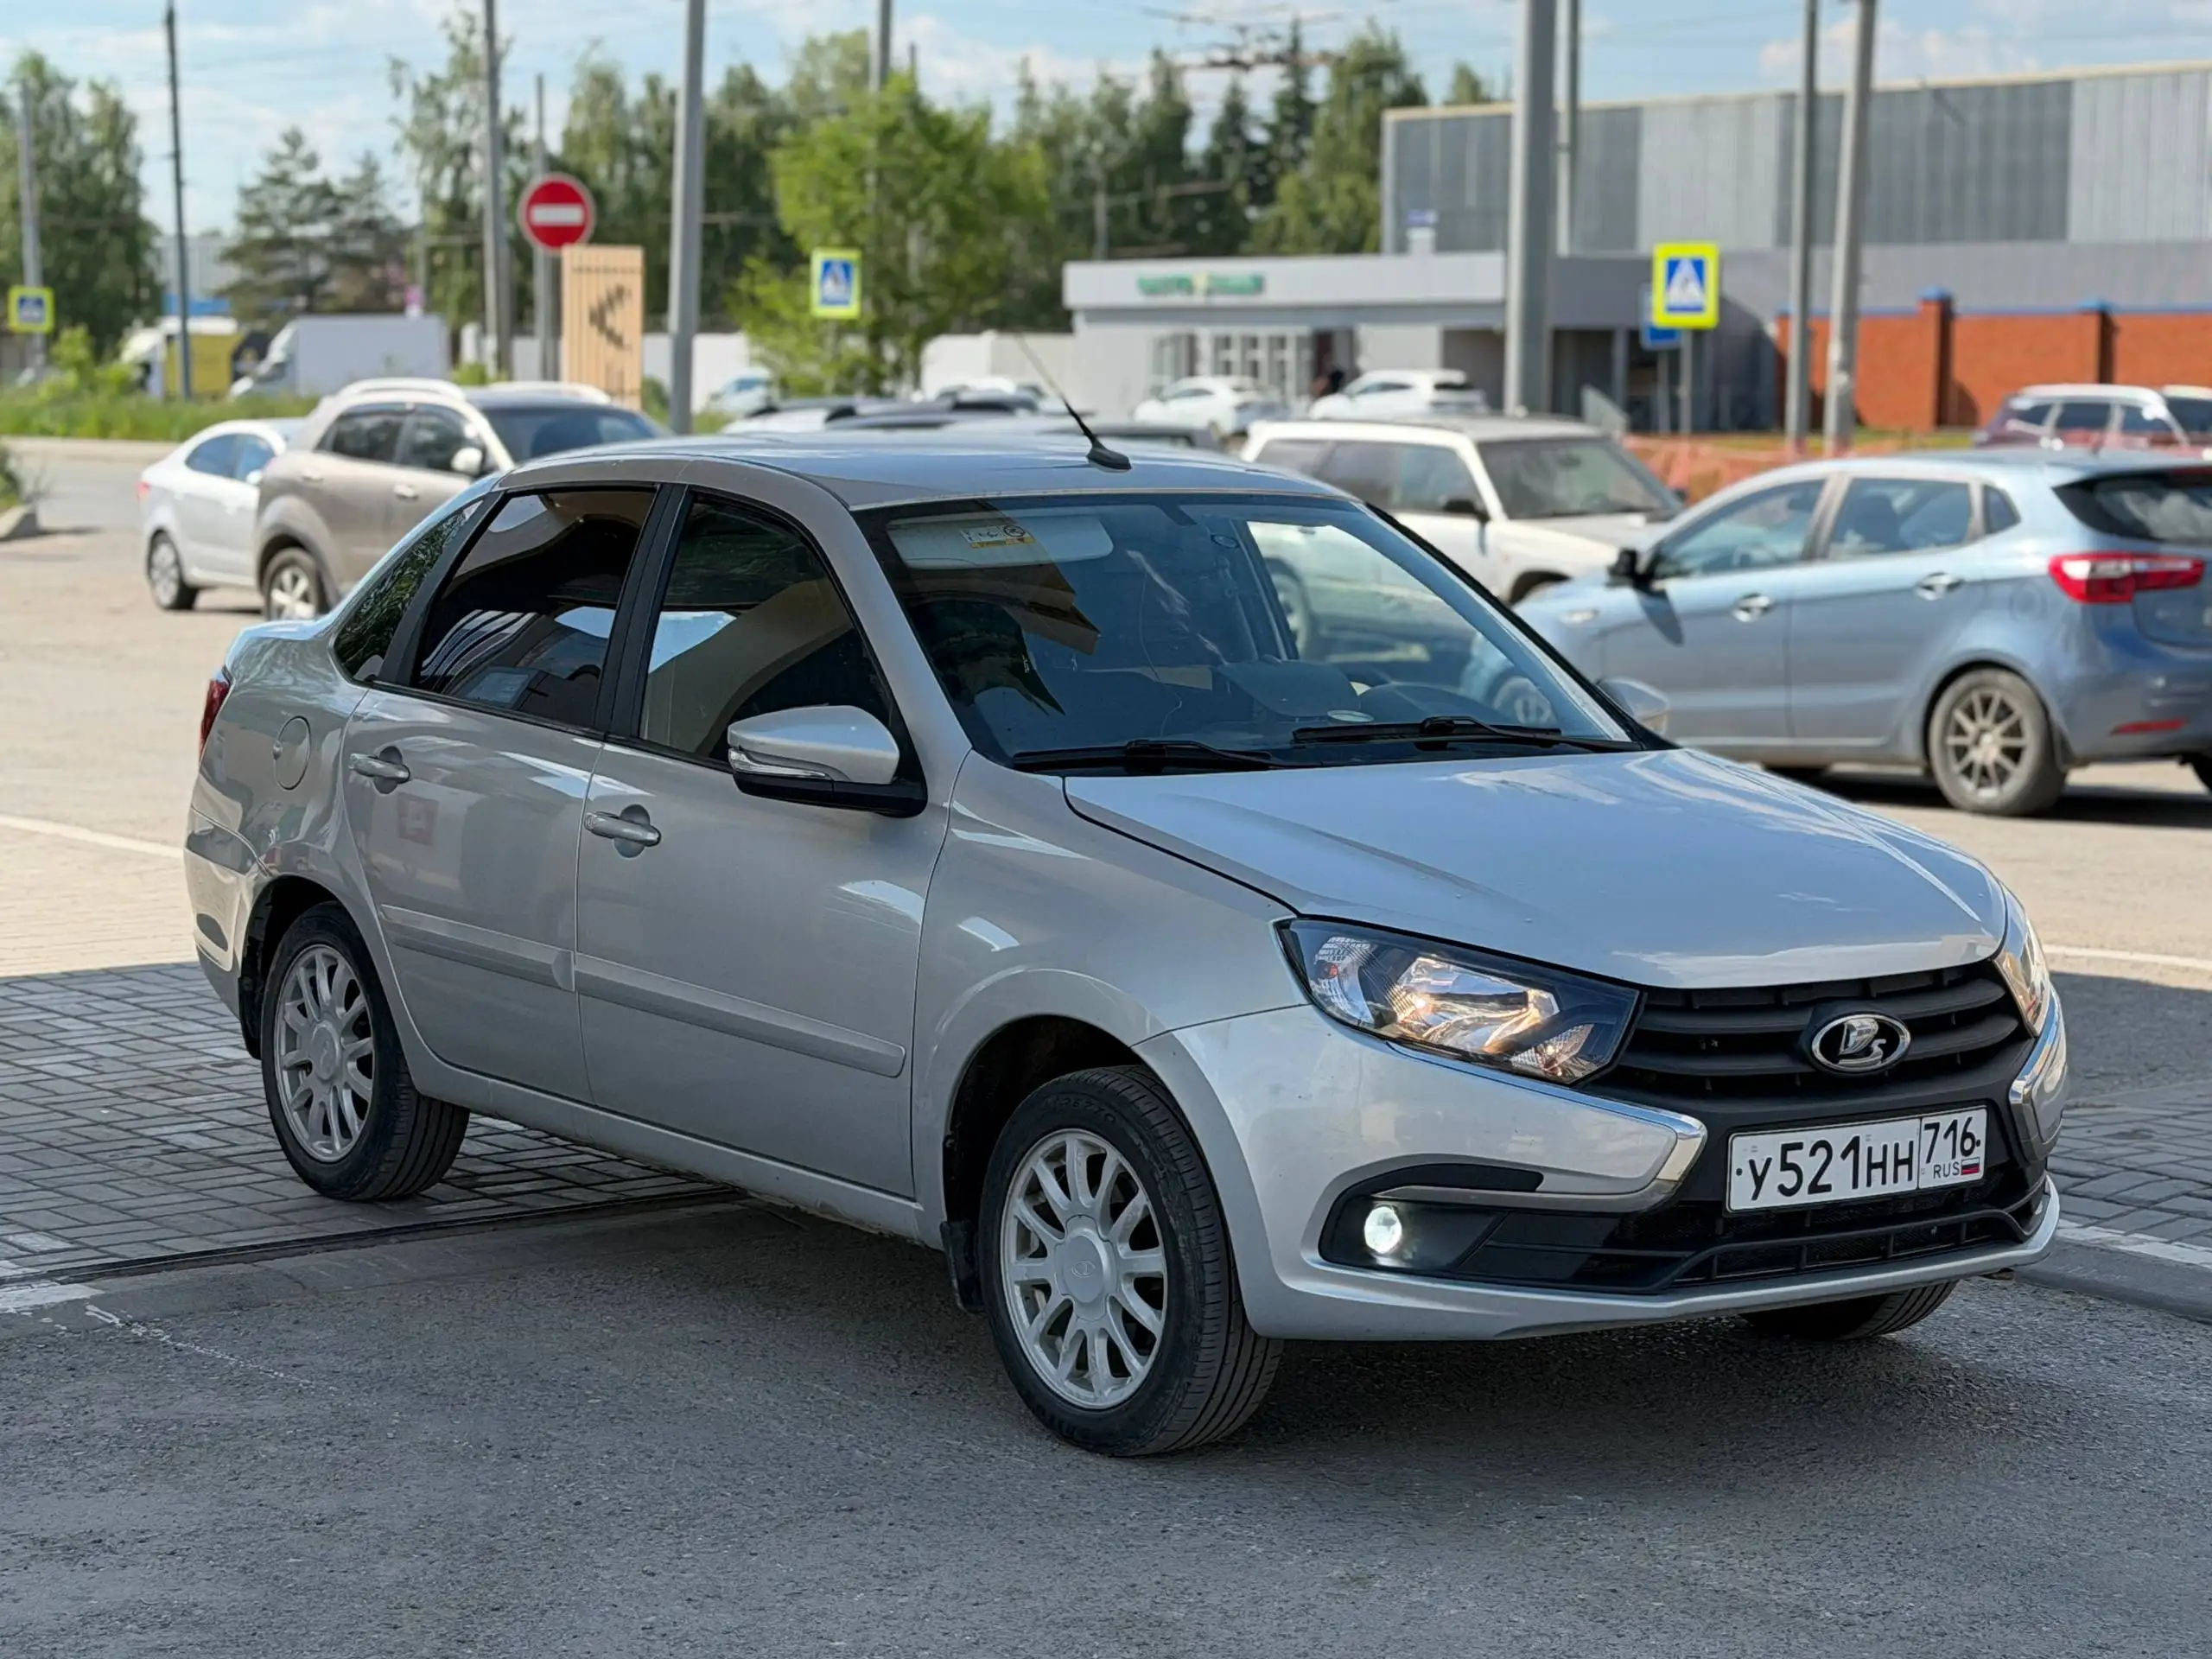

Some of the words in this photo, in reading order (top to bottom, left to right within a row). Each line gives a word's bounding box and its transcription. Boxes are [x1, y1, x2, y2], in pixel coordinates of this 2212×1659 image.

[1748, 1135, 1914, 1201] У521НН
[1923, 1116, 1976, 1164] 716
[1933, 1160, 1961, 1179] RUS
